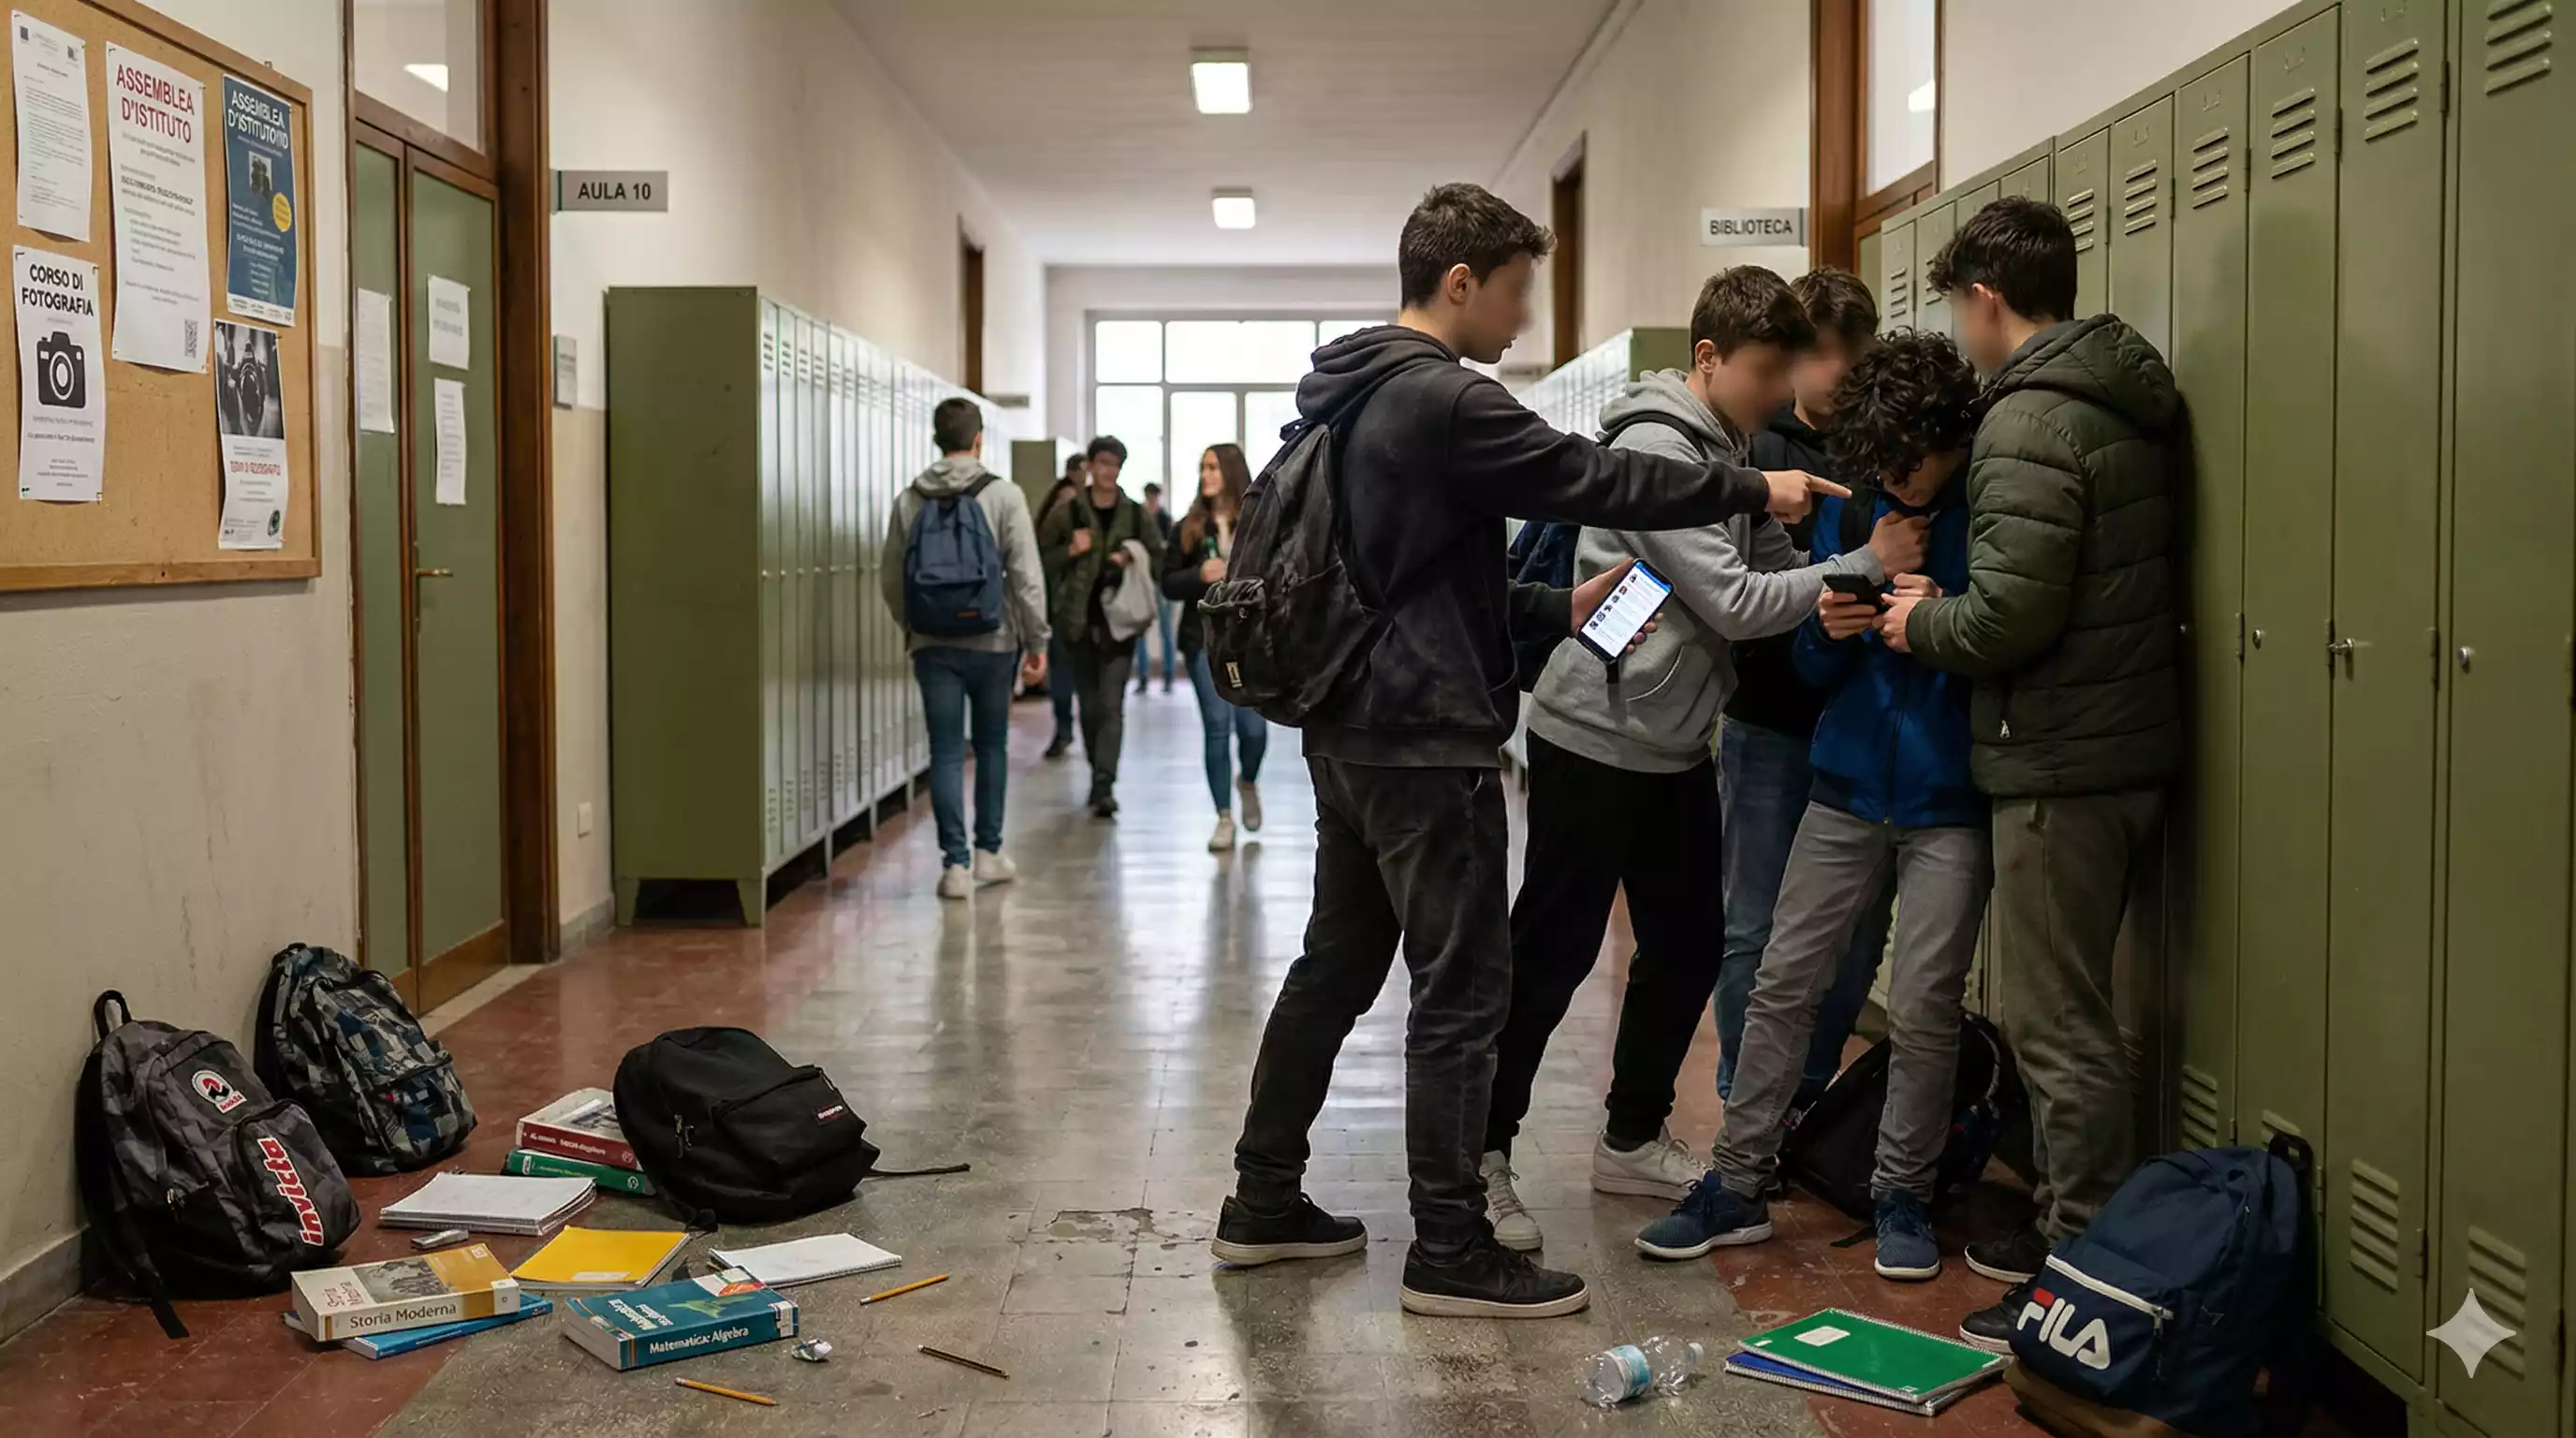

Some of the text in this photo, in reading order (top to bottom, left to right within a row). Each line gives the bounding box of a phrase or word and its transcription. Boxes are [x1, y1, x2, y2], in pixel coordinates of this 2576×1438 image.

[116, 64, 195, 115] ASSEMBLEA
[122, 96, 192, 143] D'ISTITUTO
[578, 182, 652, 200] AULA 10
[1709, 219, 1793, 235] BIBLIOTECA
[29, 263, 83, 290] CORSO DI
[22, 286, 95, 317] FOTOGRAFIA
[349, 1303, 457, 1329] Storia Moderna
[2016, 1287, 2111, 1371] FILA
